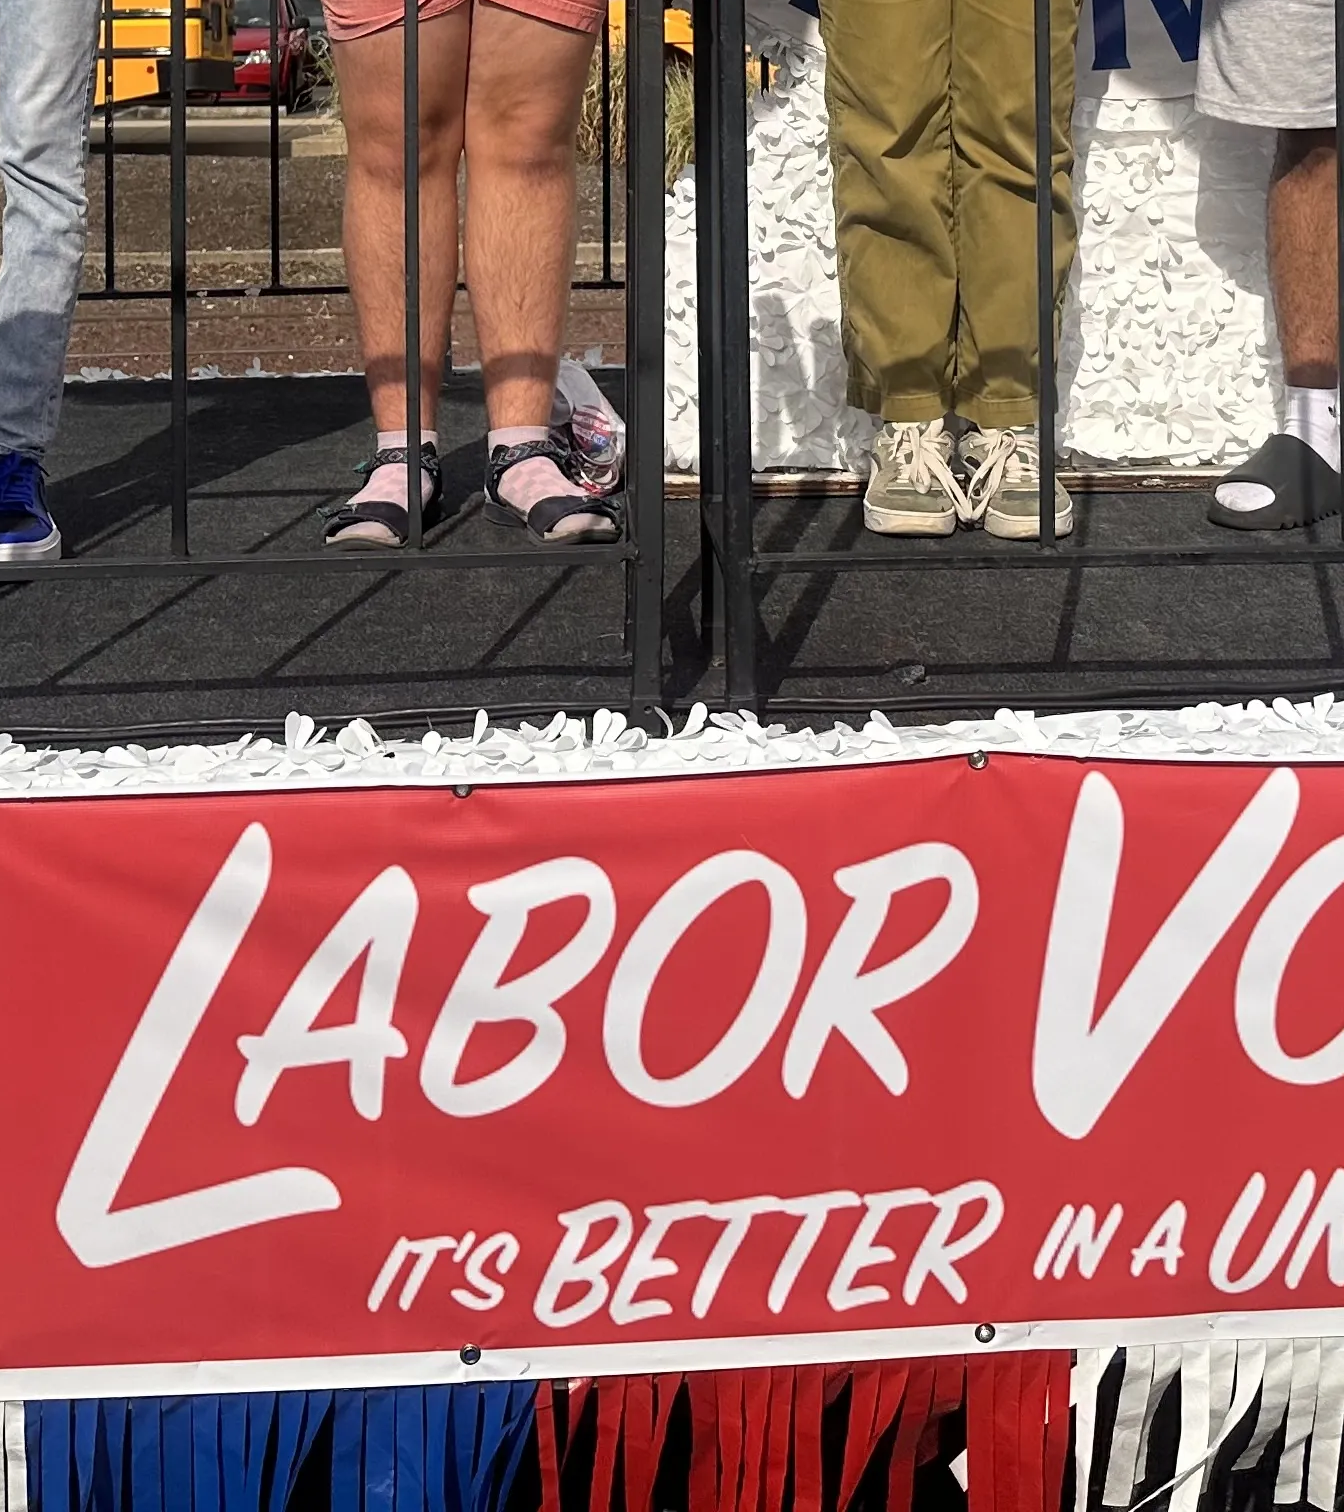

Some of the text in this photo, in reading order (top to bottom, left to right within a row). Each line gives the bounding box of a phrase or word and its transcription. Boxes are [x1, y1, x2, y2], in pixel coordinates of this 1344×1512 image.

[55, 821, 981, 1270] LABOR
[367, 1231, 519, 1314] IT'S
[532, 1180, 1005, 1329] BETTER
[1032, 1202, 1124, 1282] IN
[1129, 1200, 1188, 1278] A
